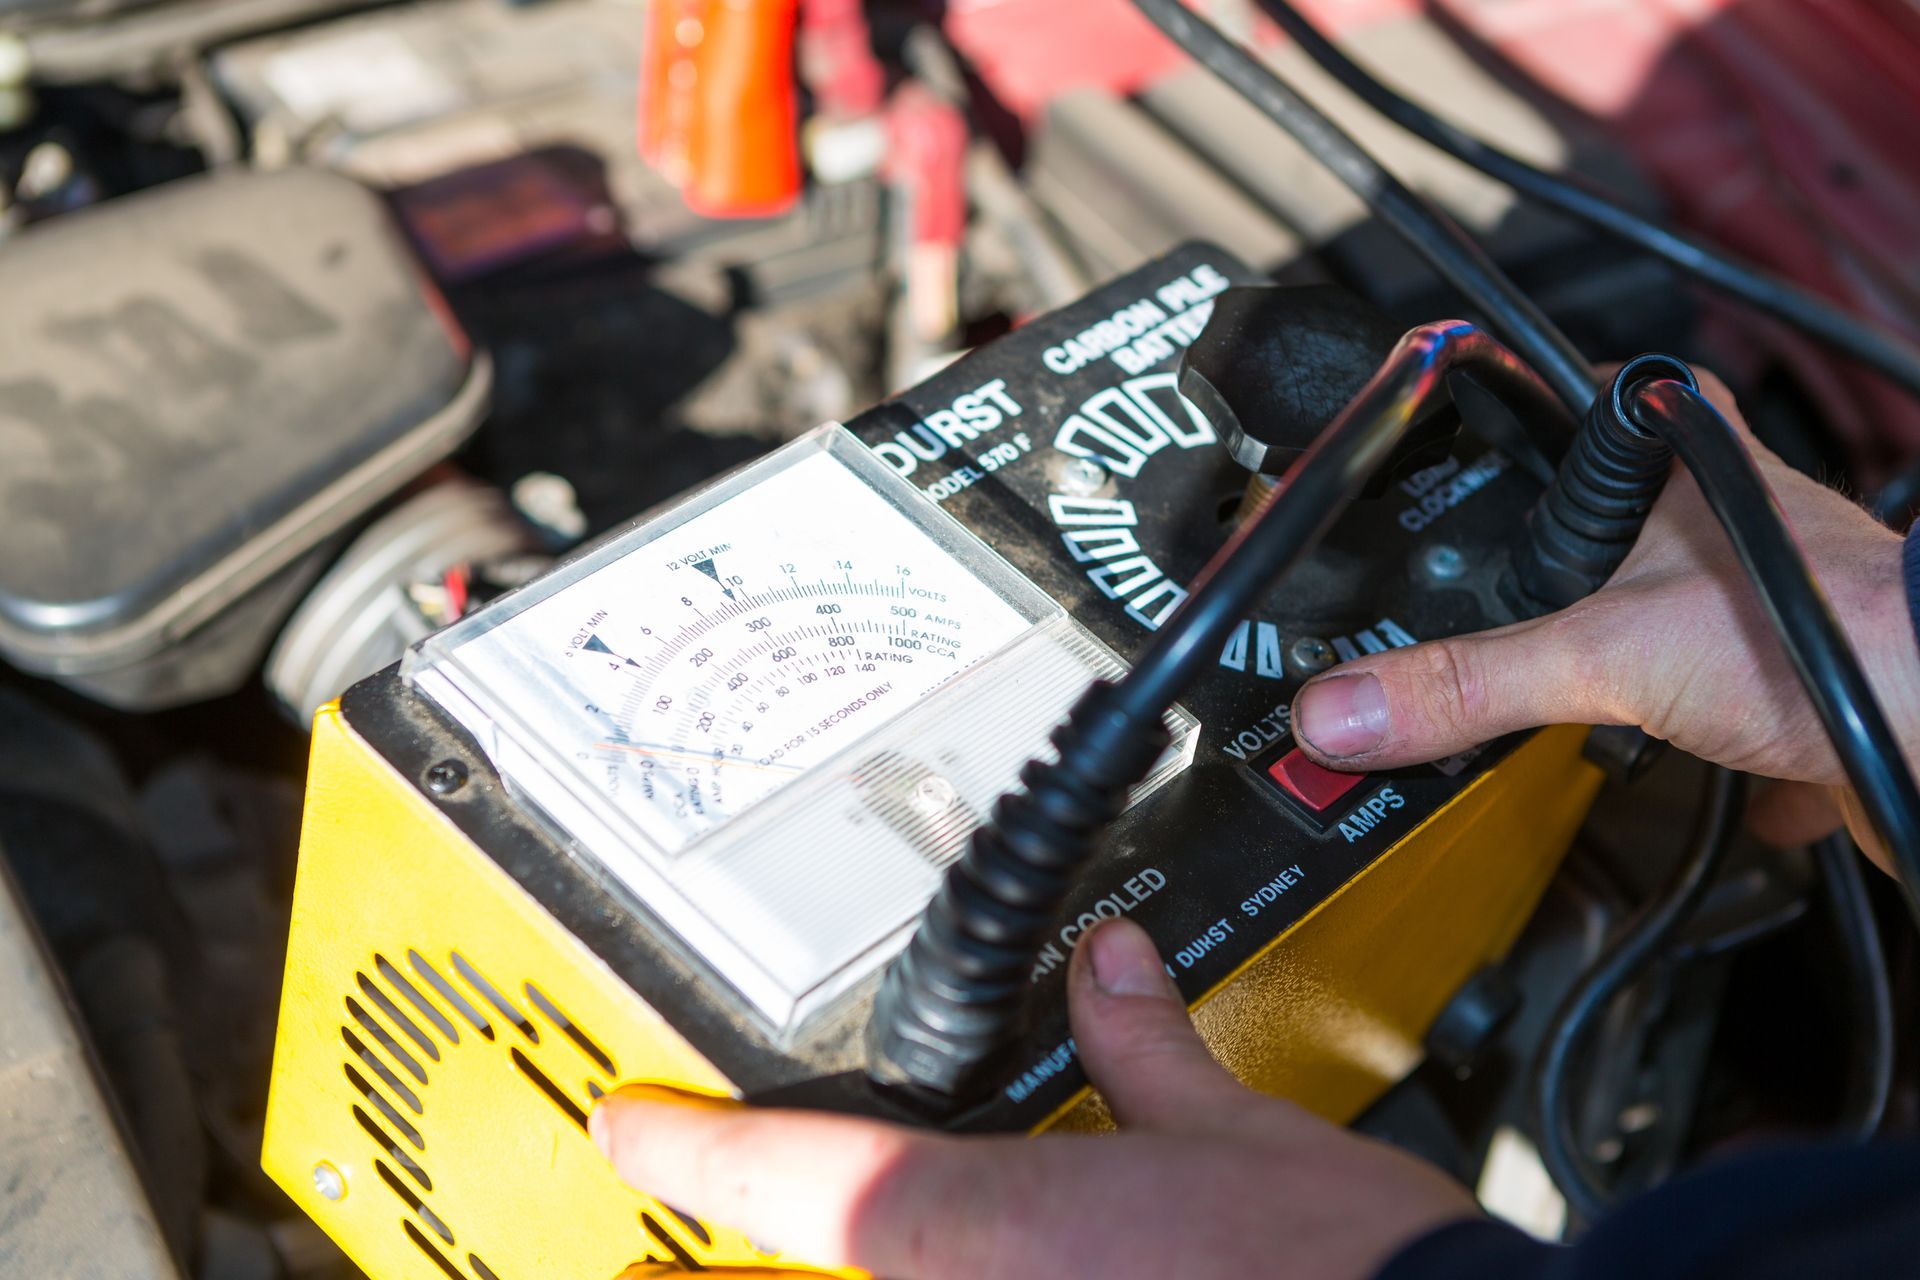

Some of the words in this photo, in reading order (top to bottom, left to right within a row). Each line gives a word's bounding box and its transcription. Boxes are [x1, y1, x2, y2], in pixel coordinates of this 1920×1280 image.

[1042, 297, 1168, 375] CARBON
[1155, 263, 1231, 314] PILE
[1111, 297, 1216, 376] BATTE
[870, 378, 1023, 478] DURST
[977, 442, 1020, 472] 570
[666, 561, 680, 572] 12
[678, 550, 707, 566] VOLT
[709, 543, 732, 557] MIN
[568, 628, 590, 649] VOLT
[587, 609, 609, 628] MIN
[585, 704, 599, 713] 2
[609, 662, 620, 671] 4
[640, 626, 652, 636] 6
[681, 596, 693, 607] 8
[725, 575, 744, 587] 10
[779, 563, 797, 574] 12
[836, 560, 853, 570] 14
[895, 565, 911, 576] 16
[908, 587, 947, 603] VOLTS
[653, 695, 673, 715] 100
[690, 647, 714, 668] 200
[745, 616, 772, 633] 300
[816, 603, 842, 615] 400
[890, 605, 917, 618] 500
[924, 613, 961, 630] AMPS
[865, 651, 914, 664] RATING
[911, 629, 961, 649] RATING
[696, 711, 715, 733] 200
[727, 672, 749, 692] 400
[771, 646, 797, 663] 600
[828, 635, 855, 648] 800
[888, 636, 921, 650] 1000
[926, 645, 957, 660] CCA
[756, 701, 769, 713] 60
[775, 685, 790, 698] 80
[797, 672, 818, 685] 100
[824, 665, 846, 677] 120
[855, 663, 876, 672] 140
[755, 748, 785, 766] OAD
[784, 735, 806, 751] FOR
[805, 727, 821, 738] 15
[818, 698, 867, 730] SECONDS
[865, 680, 894, 702] ONLY
[1337, 787, 1406, 844] AMPS
[1175, 917, 1235, 969] DURST
[1240, 864, 1305, 917] SYDNEY
[1031, 942, 1066, 984] AN
